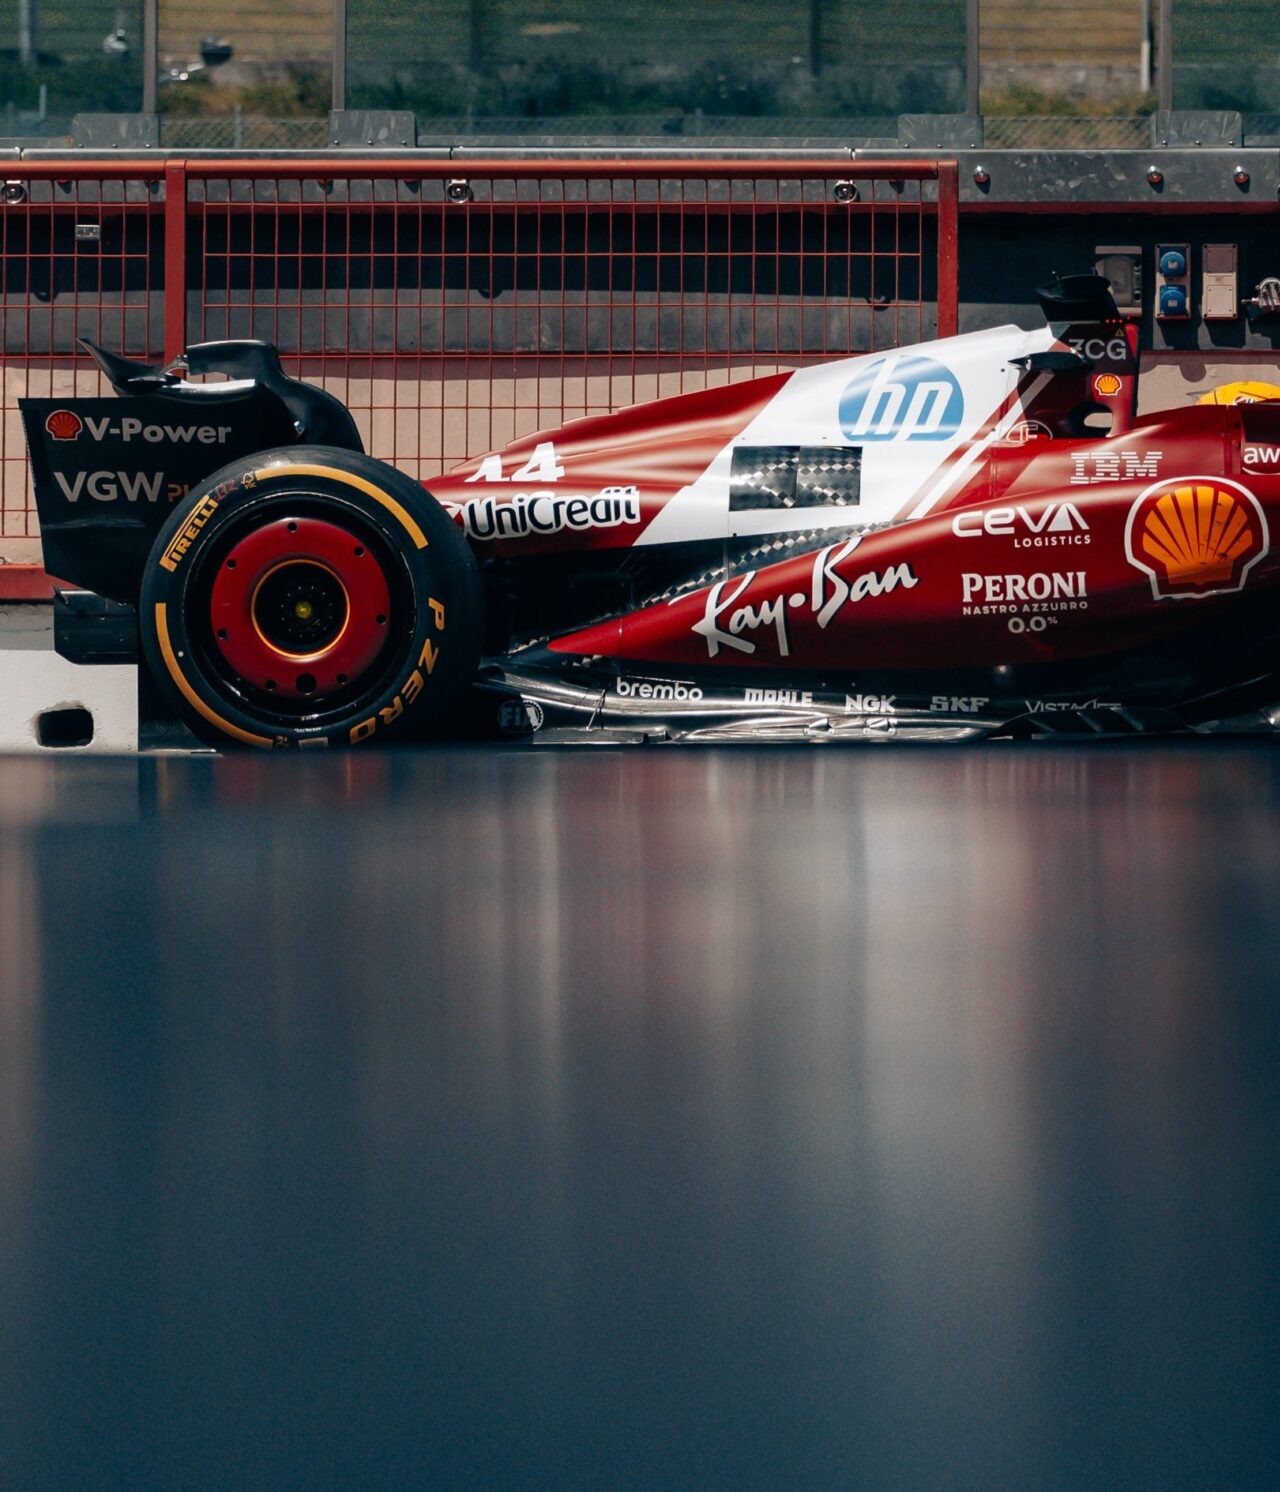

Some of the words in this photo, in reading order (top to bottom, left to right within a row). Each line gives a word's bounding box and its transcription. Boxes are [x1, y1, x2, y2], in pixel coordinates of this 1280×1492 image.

[850, 356, 955, 442] hp
[84, 417, 232, 444] V-Power
[464, 442, 565, 482] 14
[1070, 451, 1163, 484] IBM
[53, 471, 164, 503] VGW
[467, 487, 639, 539] UniCredit
[159, 494, 219, 573] PIRELLI
[1014, 534, 1091, 548] LOGISTICS
[961, 571, 1088, 603] PERONI
[962, 604, 1018, 616] NASTRO
[1022, 601, 1088, 613] AZZURRO
[1008, 616, 1058, 634] 0.0%
[616, 676, 704, 701] brembo
[744, 688, 813, 707] MAHLE
[845, 694, 899, 714] NGK
[930, 695, 990, 712] SKF
